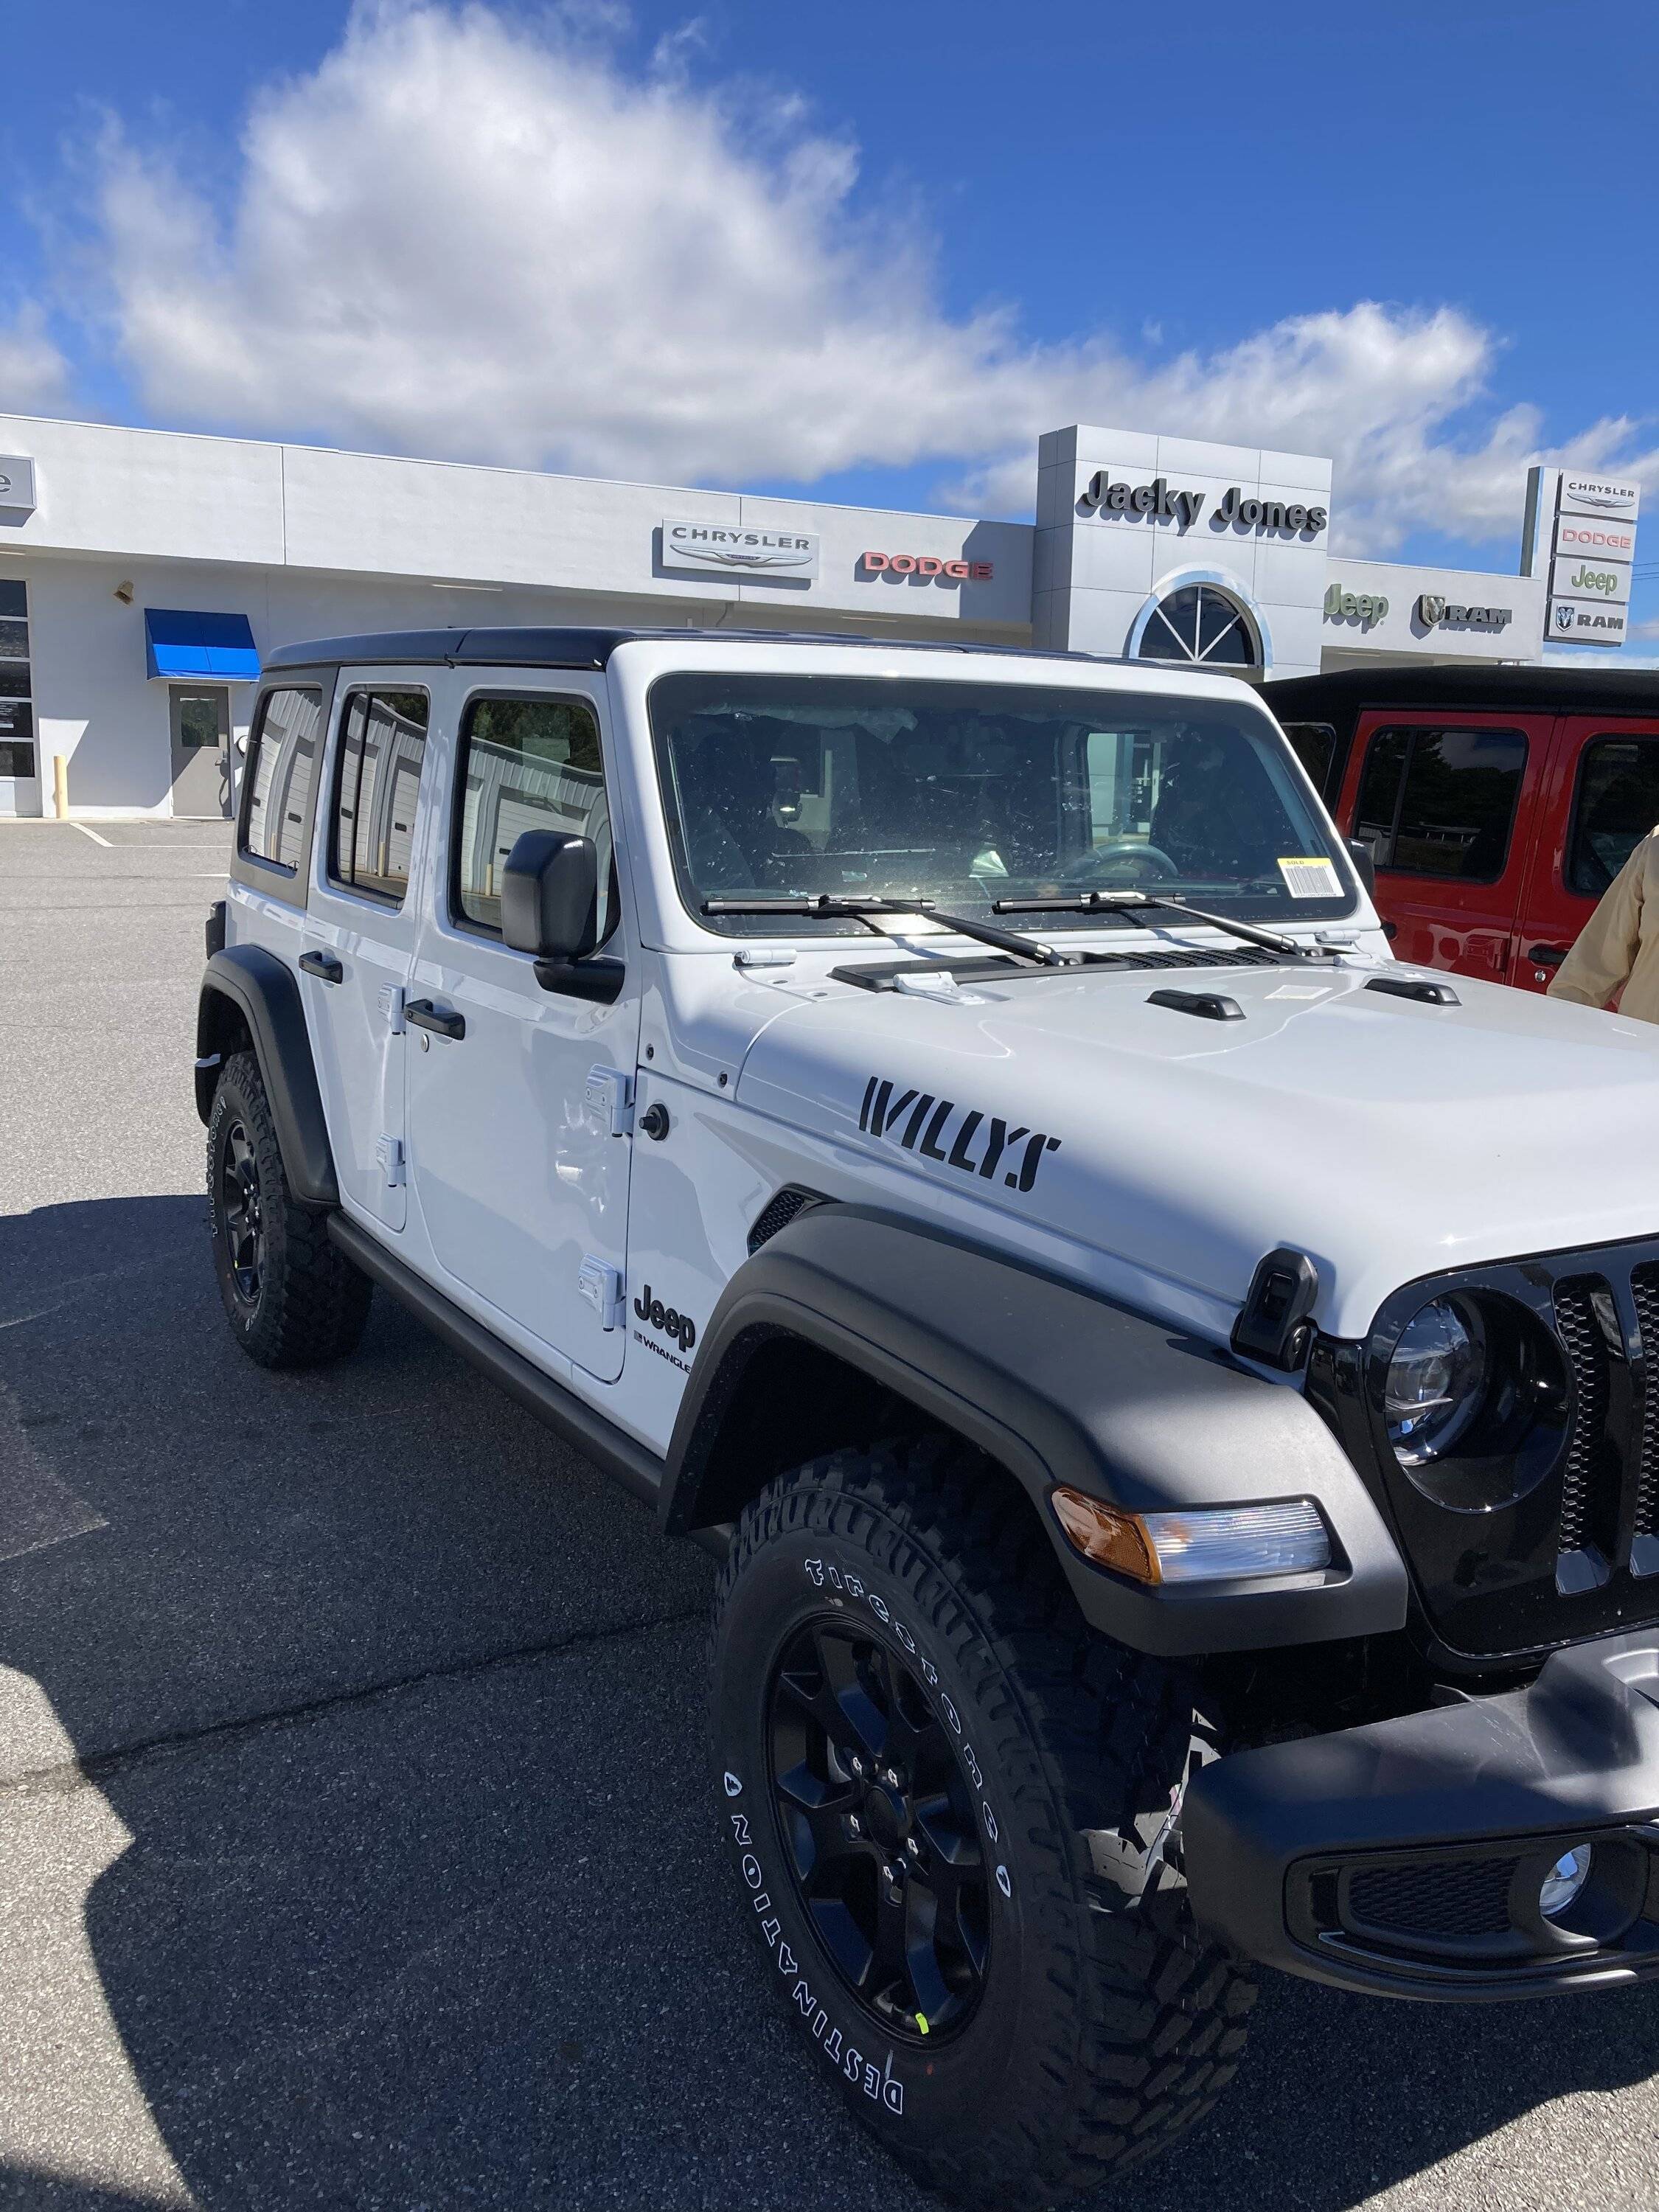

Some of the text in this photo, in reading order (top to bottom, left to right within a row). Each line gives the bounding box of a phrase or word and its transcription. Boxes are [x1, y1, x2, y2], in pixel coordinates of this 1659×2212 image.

[1083, 470, 1327, 532] Jacky Jones
[1568, 482, 1635, 497] CHRYSLER
[672, 527, 810, 550] CHRYSLER
[1562, 529, 1631, 549] DODGE
[863, 552, 993, 580] DODGE
[1571, 565, 1618, 595] Jeep
[1324, 583, 1388, 625] Jeep
[1445, 605, 1512, 624] RAM
[1577, 614, 1624, 630] RAM
[858, 1076, 1062, 1193] WILLYS
[634, 1284, 696, 1353] Jeep
[643, 1335, 692, 1374] WRANGLE
[731, 1814, 904, 2115] DESTINATION
